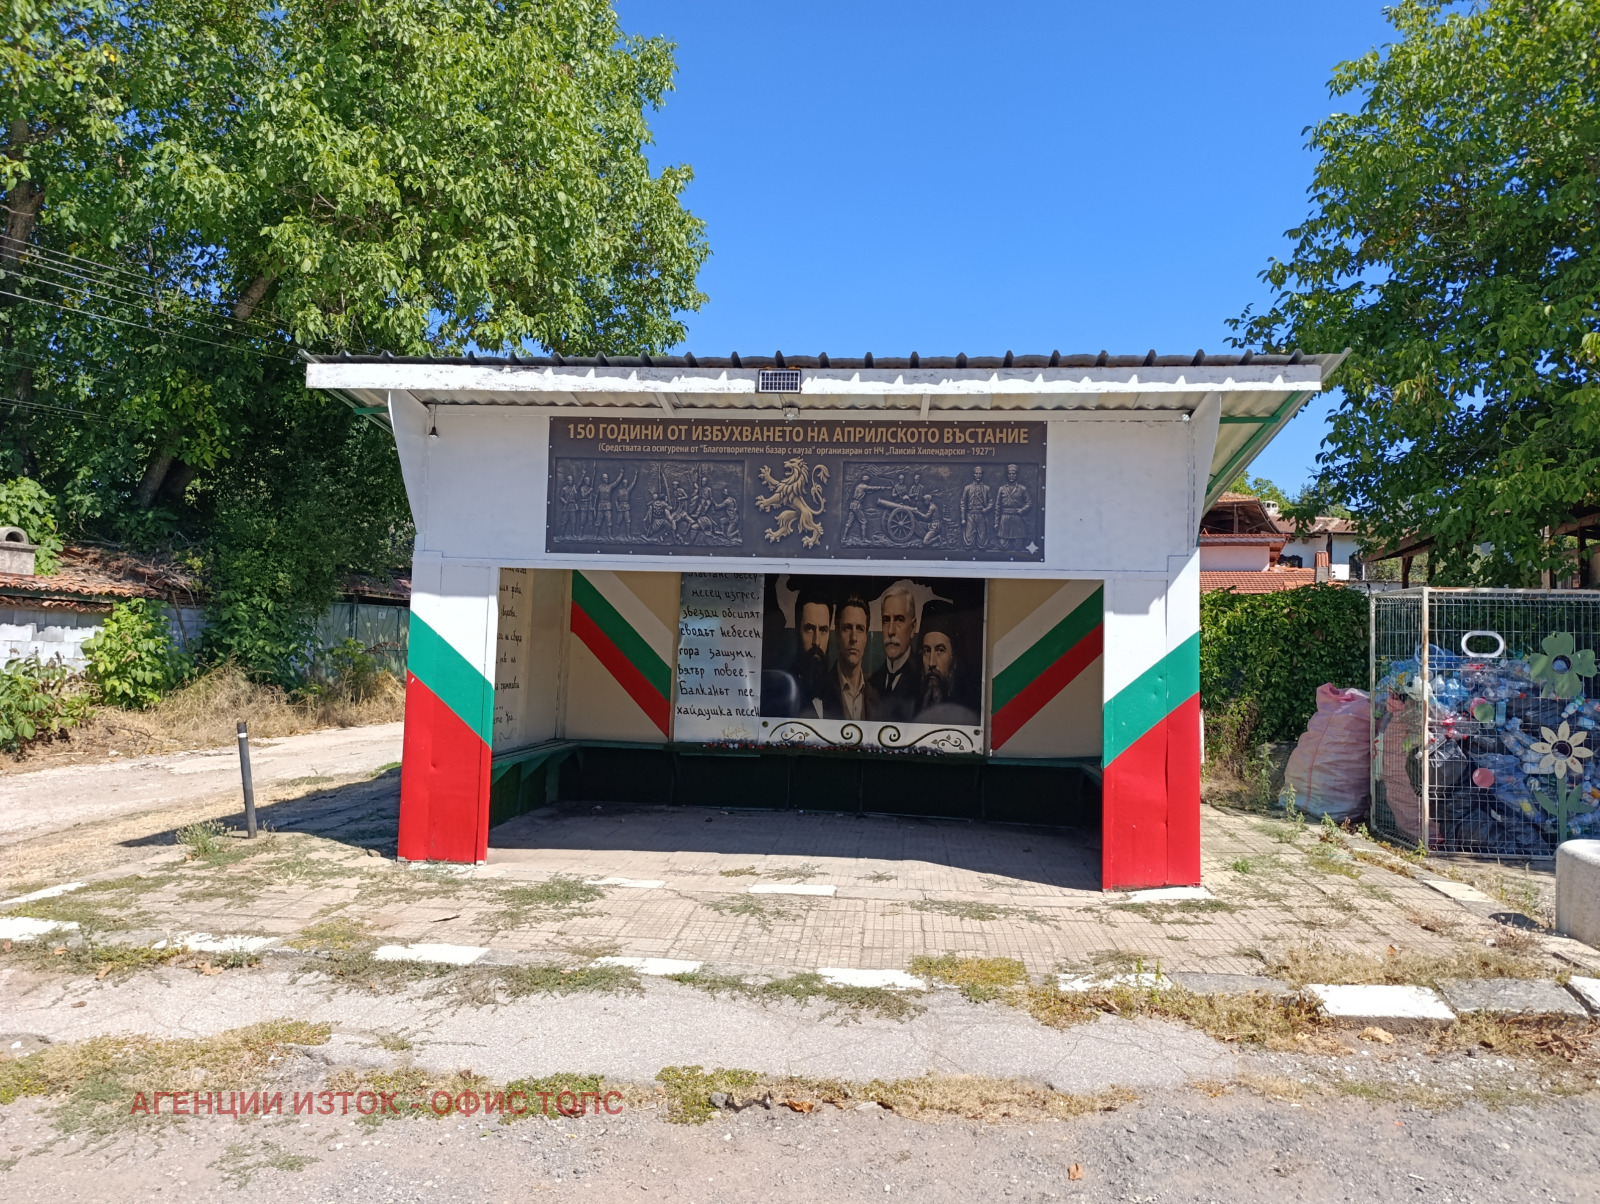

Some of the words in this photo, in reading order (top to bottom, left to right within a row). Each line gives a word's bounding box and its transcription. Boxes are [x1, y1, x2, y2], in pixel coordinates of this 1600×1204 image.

[568, 424, 595, 439] 150
[599, 424, 663, 442] ГОДИНИ
[667, 425, 688, 441] ОТ
[692, 426, 804, 442] ИЗБУХВАНЕТО
[807, 427, 829, 442] НА
[833, 427, 939, 443] АПРИЛСКОТО
[943, 428, 1029, 443] ВЪСТАНИЕ
[598, 442, 641, 453] (Средствата
[652, 445, 689, 454] осигурени
[765, 445, 786, 456] базар
[817, 447, 862, 456] организиран
[874, 447, 884, 455] НЧ
[917, 447, 966, 457] Хилендарски
[692, 589, 722, 600] месец
[682, 605, 719, 619] звезди
[722, 607, 760, 619] обсипят
[680, 623, 715, 637] сводът
[679, 647, 700, 659] гора
[738, 688, 755, 697] пее
[676, 704, 733, 720] хайдушка
[735, 705, 760, 717] песен
